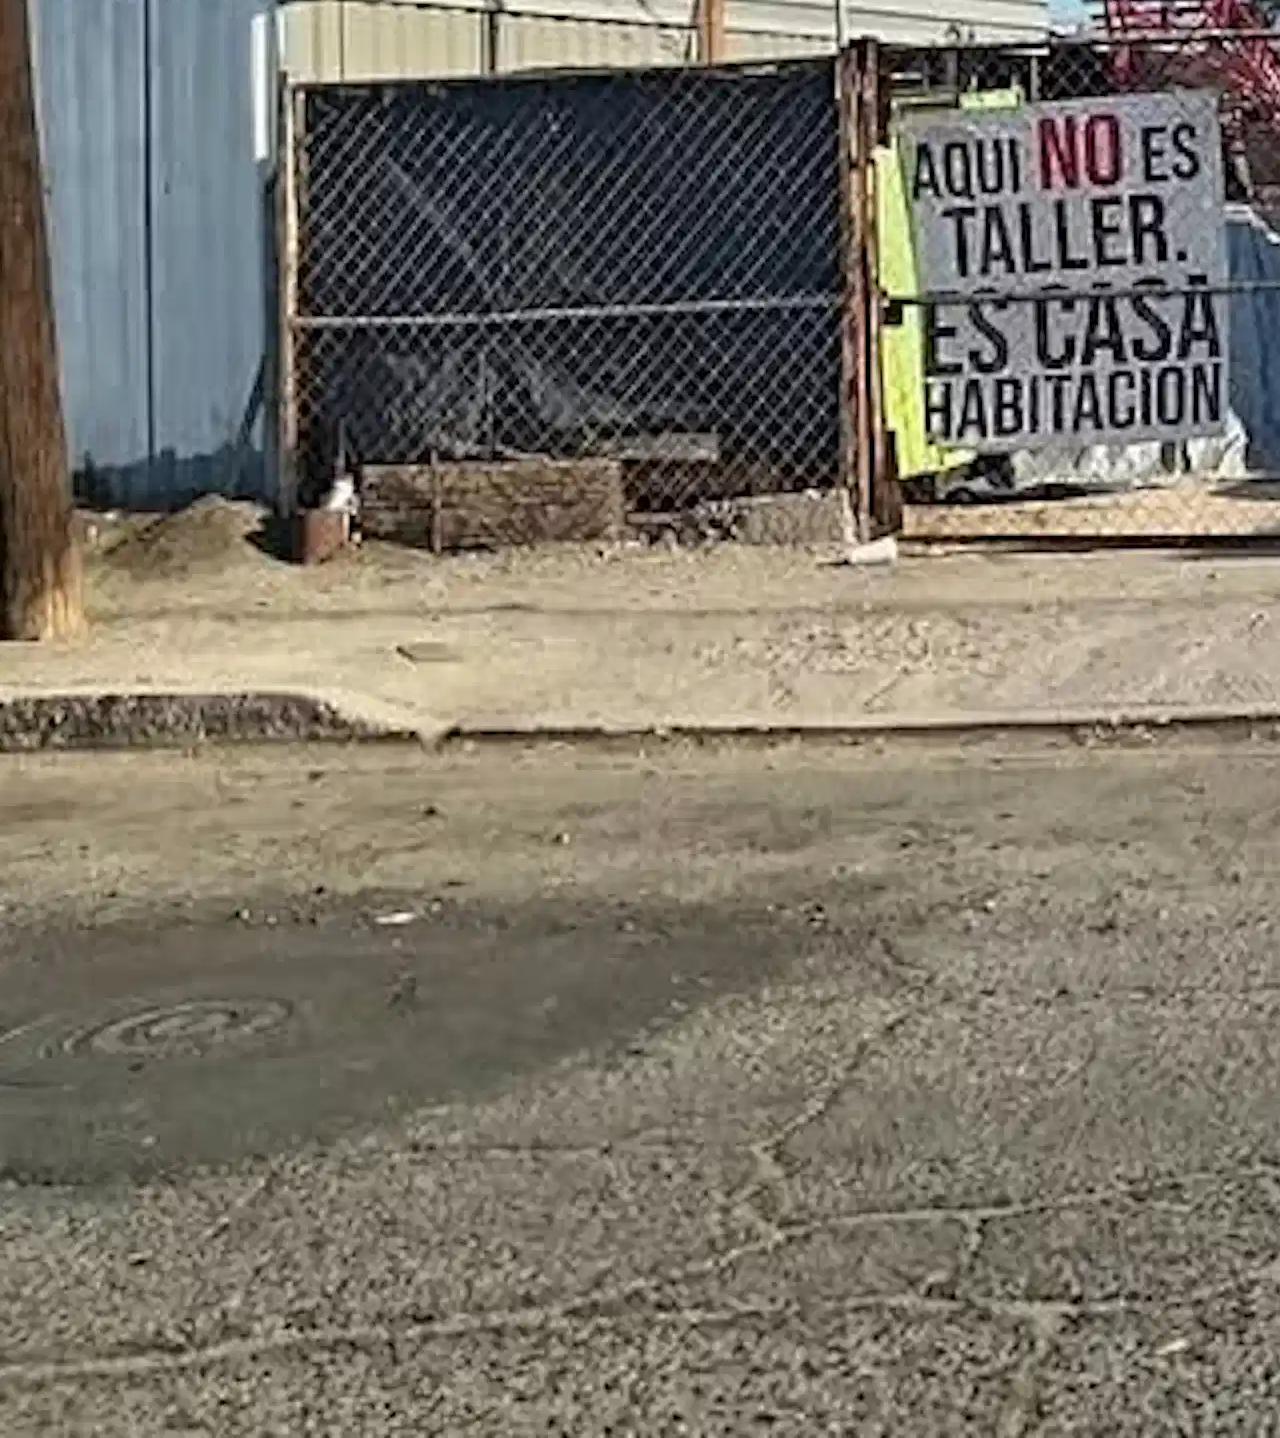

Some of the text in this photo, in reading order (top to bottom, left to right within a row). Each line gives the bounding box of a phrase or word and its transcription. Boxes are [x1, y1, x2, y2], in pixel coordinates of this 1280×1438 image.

[913, 115, 1200, 200] AQUI NO ES
[942, 195, 1188, 276] TALLER.
[924, 275, 1222, 374] ES CASA
[923, 364, 1221, 440] HABITACION
